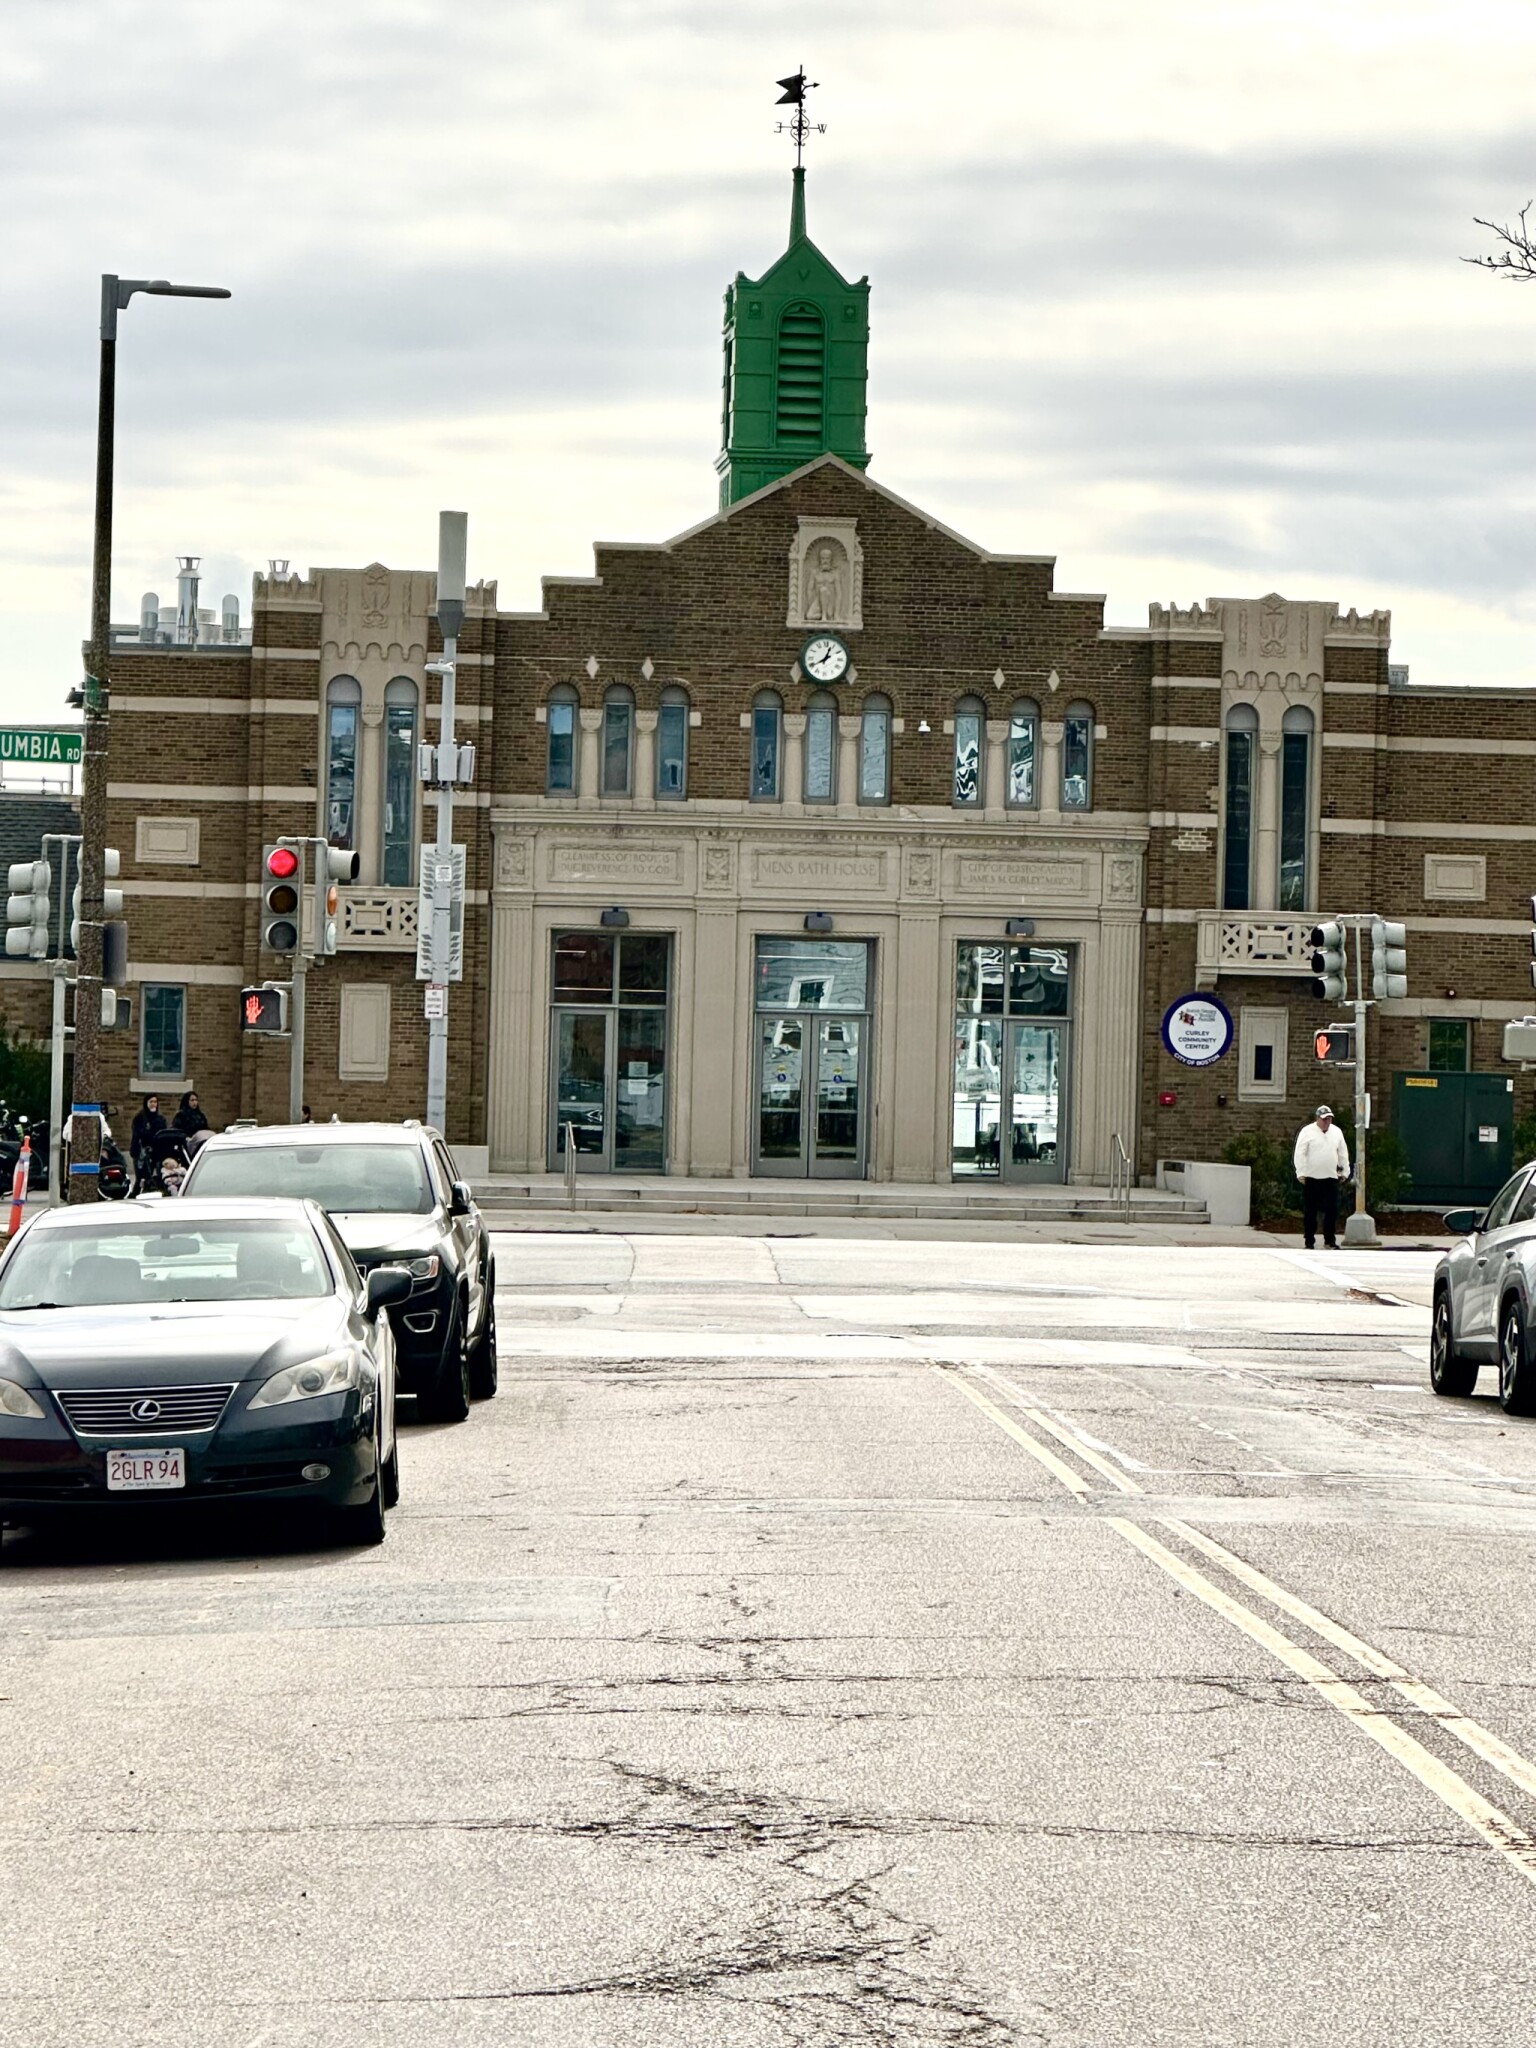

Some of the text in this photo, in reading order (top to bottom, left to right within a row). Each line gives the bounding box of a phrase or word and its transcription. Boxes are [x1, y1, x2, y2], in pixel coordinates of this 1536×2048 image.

[817, 123, 828, 134] W
[1, 734, 80, 760] UMBIA RD
[798, 862, 829, 875] BATH
[834, 863, 877, 876] HOUSE
[968, 863, 989, 872] CITY
[990, 864, 1005, 872] OF
[1174, 1053, 1186, 1063] CITY
[1196, 1054, 1220, 1065] BOSTON
[111, 1460, 179, 1481] 2GLR 94
